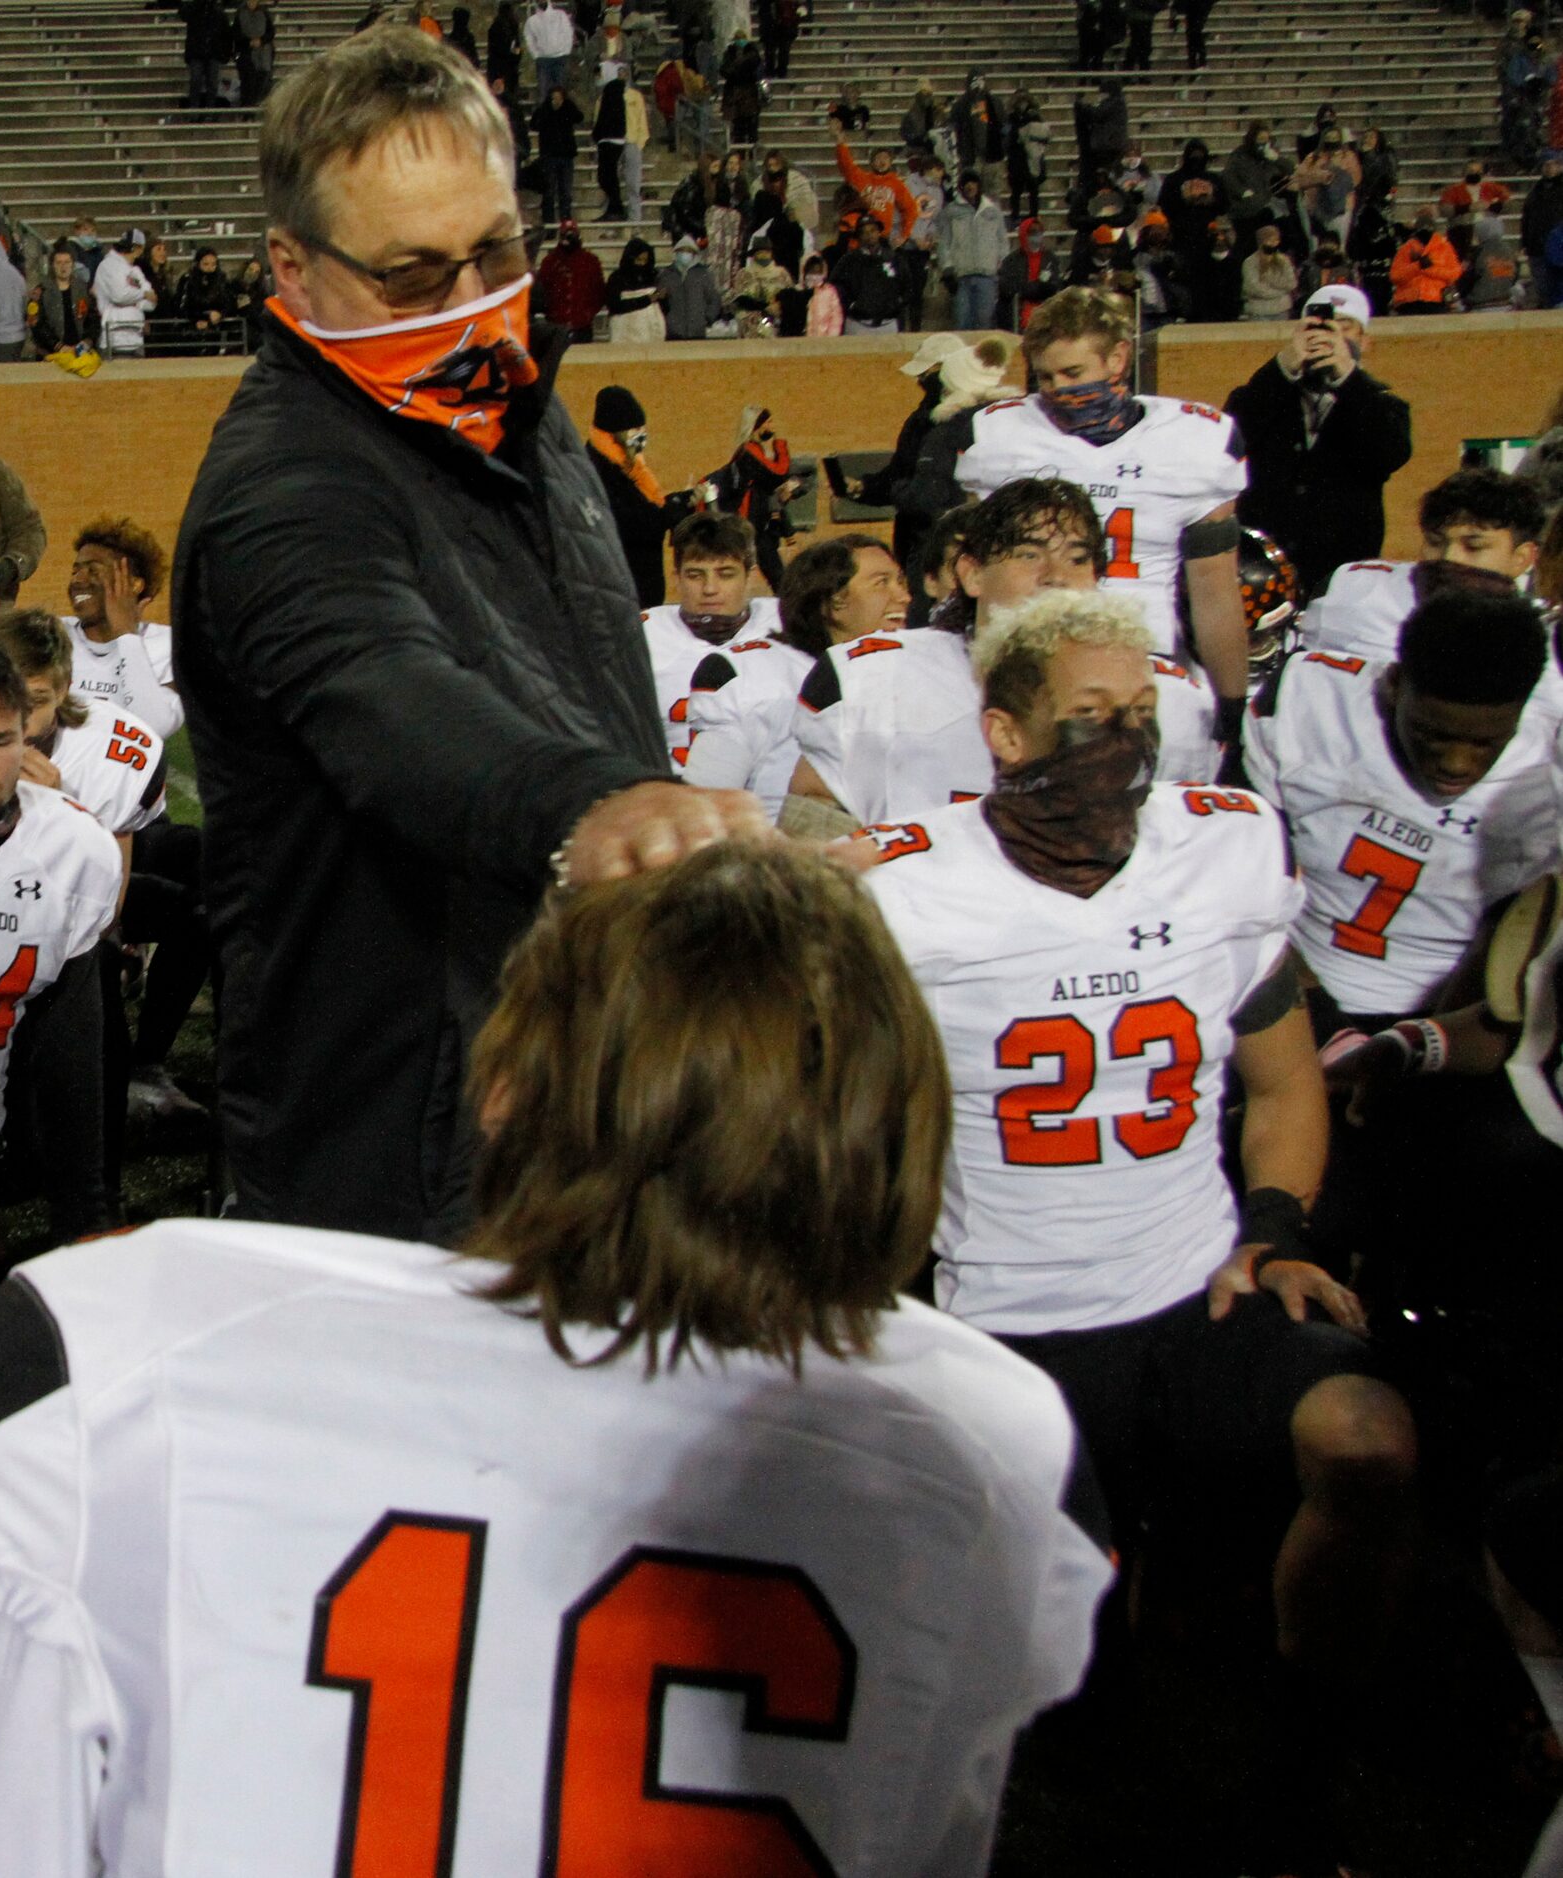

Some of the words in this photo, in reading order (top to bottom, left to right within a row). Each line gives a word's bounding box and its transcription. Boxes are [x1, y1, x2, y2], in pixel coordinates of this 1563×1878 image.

[1088, 483, 1119, 499] EDO
[78, 680, 119, 694] ALEDO
[105, 719, 152, 771] 55
[1361, 811, 1434, 854] ALEDO
[1331, 832, 1426, 960] 7
[1050, 970, 1140, 1001] ALEDO
[993, 994, 1204, 1168] 23
[305, 1510, 859, 1878] 16
